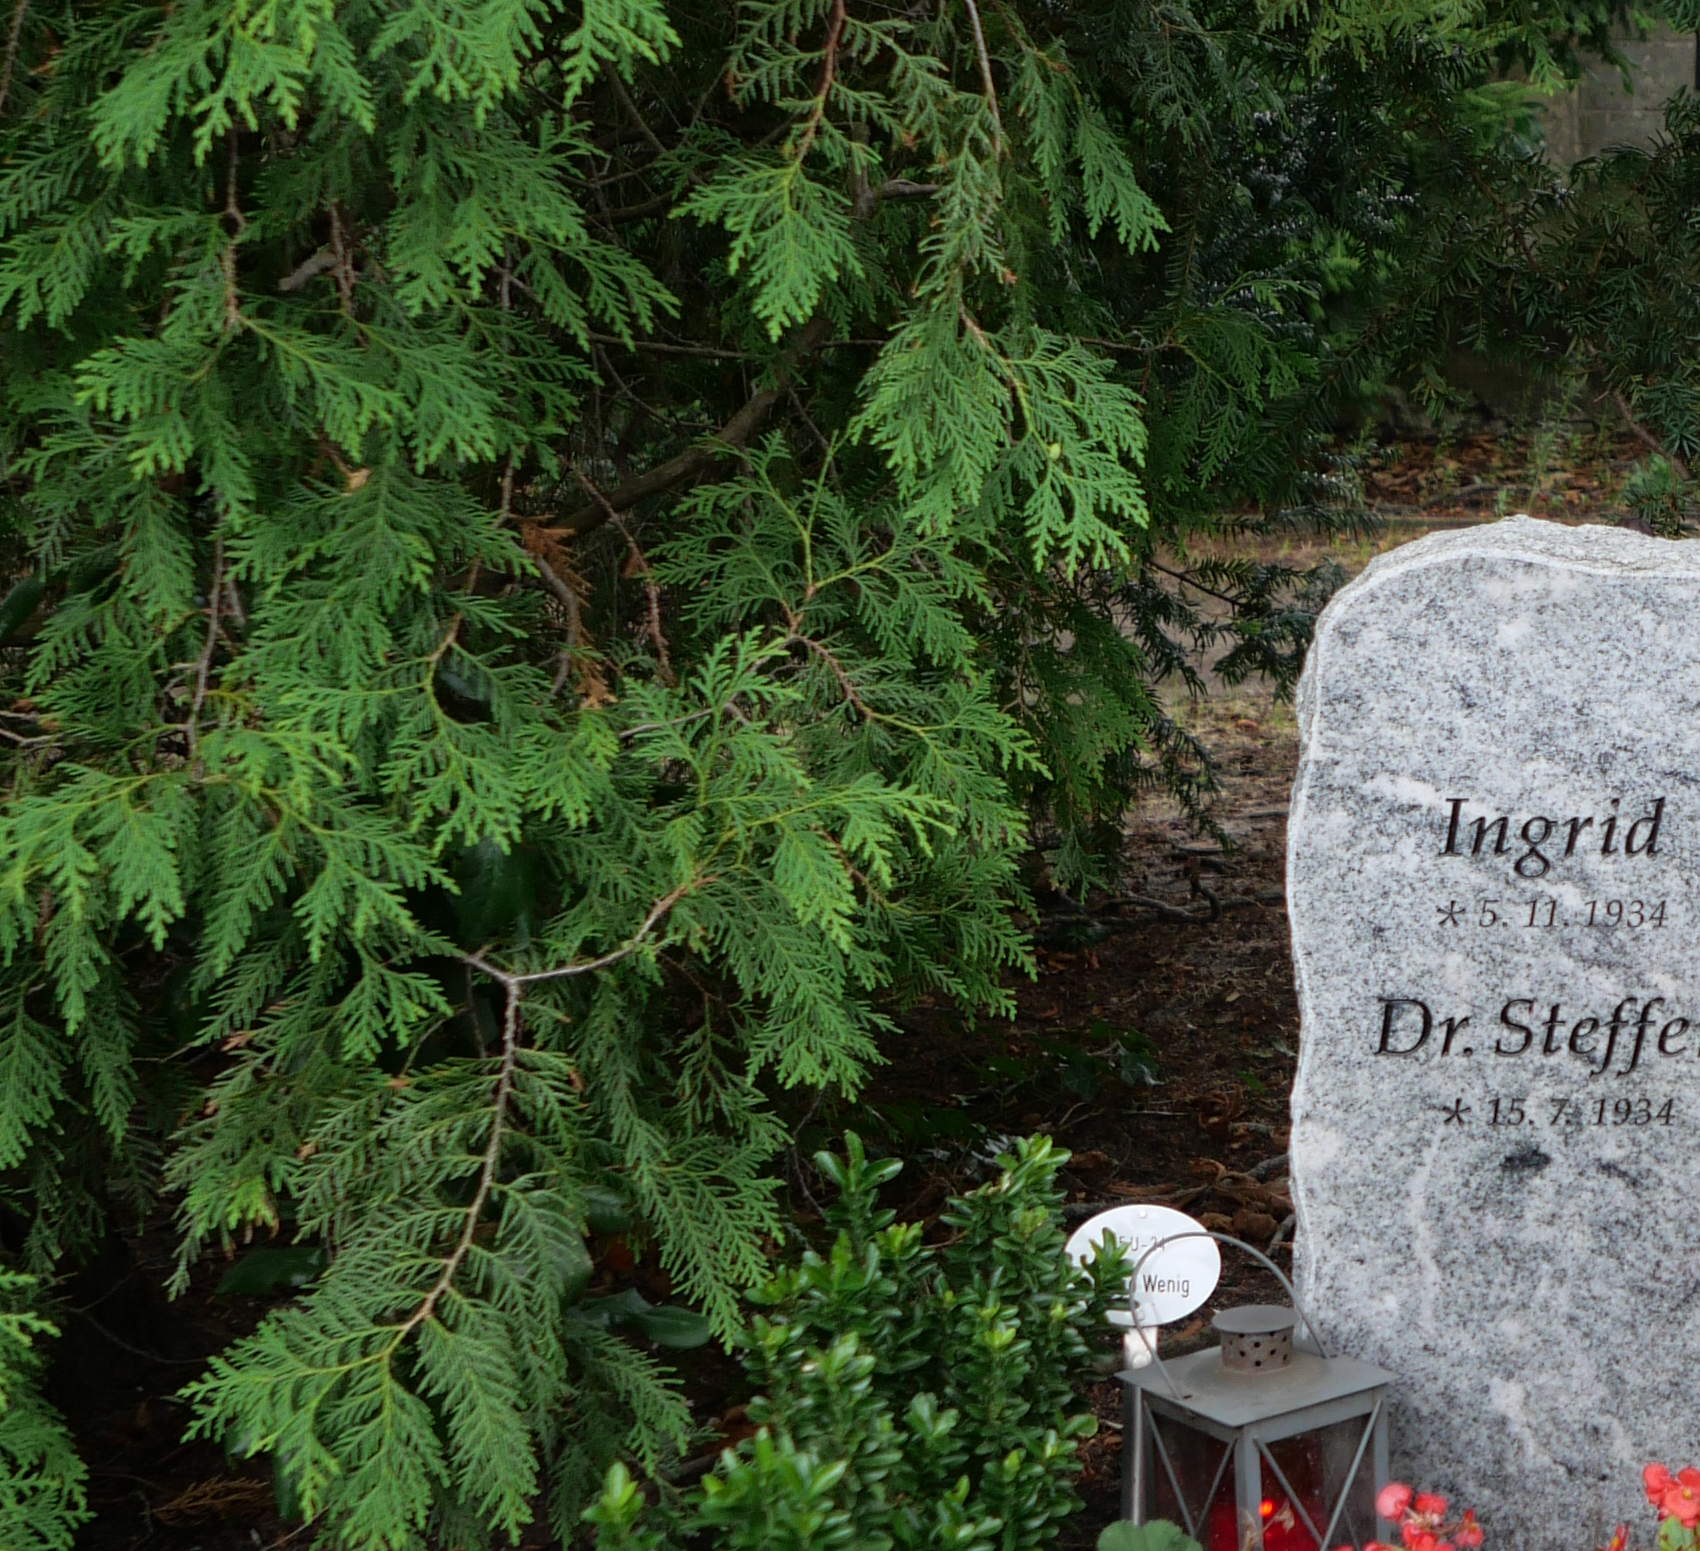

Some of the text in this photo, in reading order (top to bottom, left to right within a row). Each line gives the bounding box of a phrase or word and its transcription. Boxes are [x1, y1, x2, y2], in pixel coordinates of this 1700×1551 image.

[1438, 796, 1667, 879] Ingrid
[1584, 899, 1669, 930] 1934
[1374, 997, 1474, 1057] Dr.
[1592, 1098, 1677, 1127] 1934
[1142, 1274, 1190, 1298] Wenig
